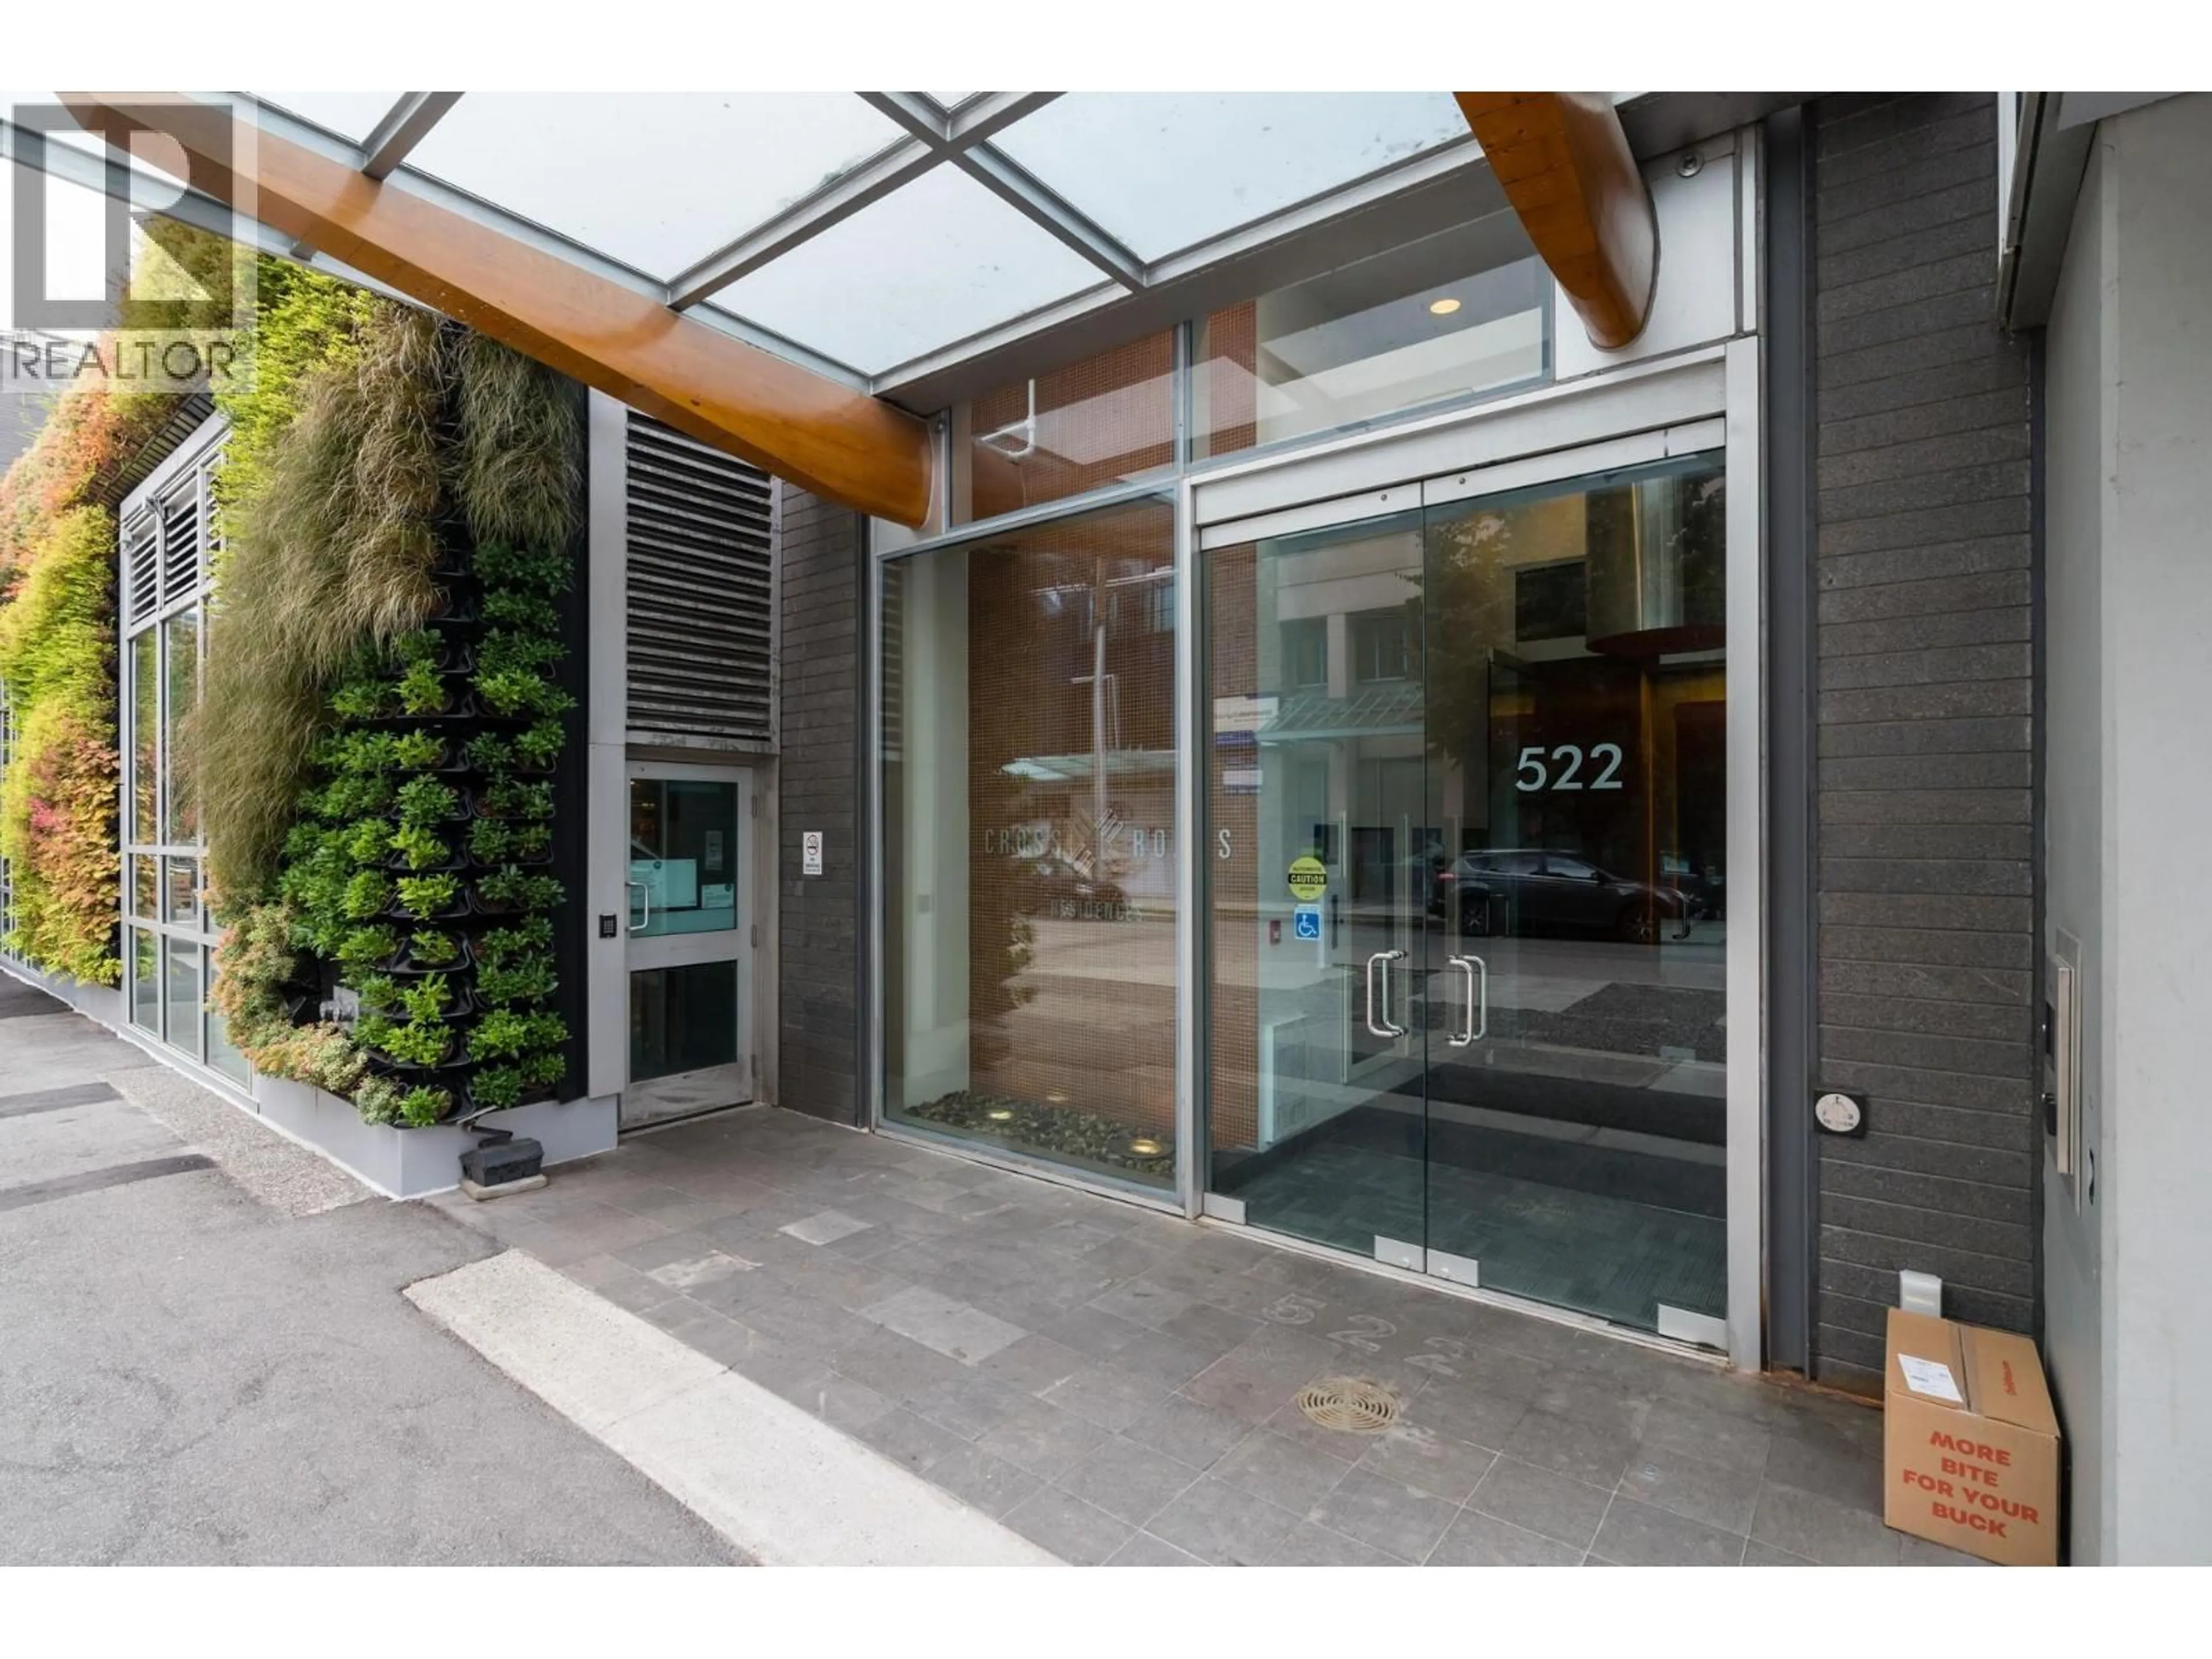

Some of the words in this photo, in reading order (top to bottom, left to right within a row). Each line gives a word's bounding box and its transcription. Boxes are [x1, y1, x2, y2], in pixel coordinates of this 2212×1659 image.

[1515, 743, 1623, 791] 522
[1290, 874, 1324, 884] CAUTION
[1930, 1430, 2012, 1467] MORE
[1941, 1457, 1999, 1487] BITE
[1903, 1469, 1954, 1498] FOR
[1962, 1486, 2039, 1525] YOUR
[1931, 1501, 2007, 1538] BUCK
